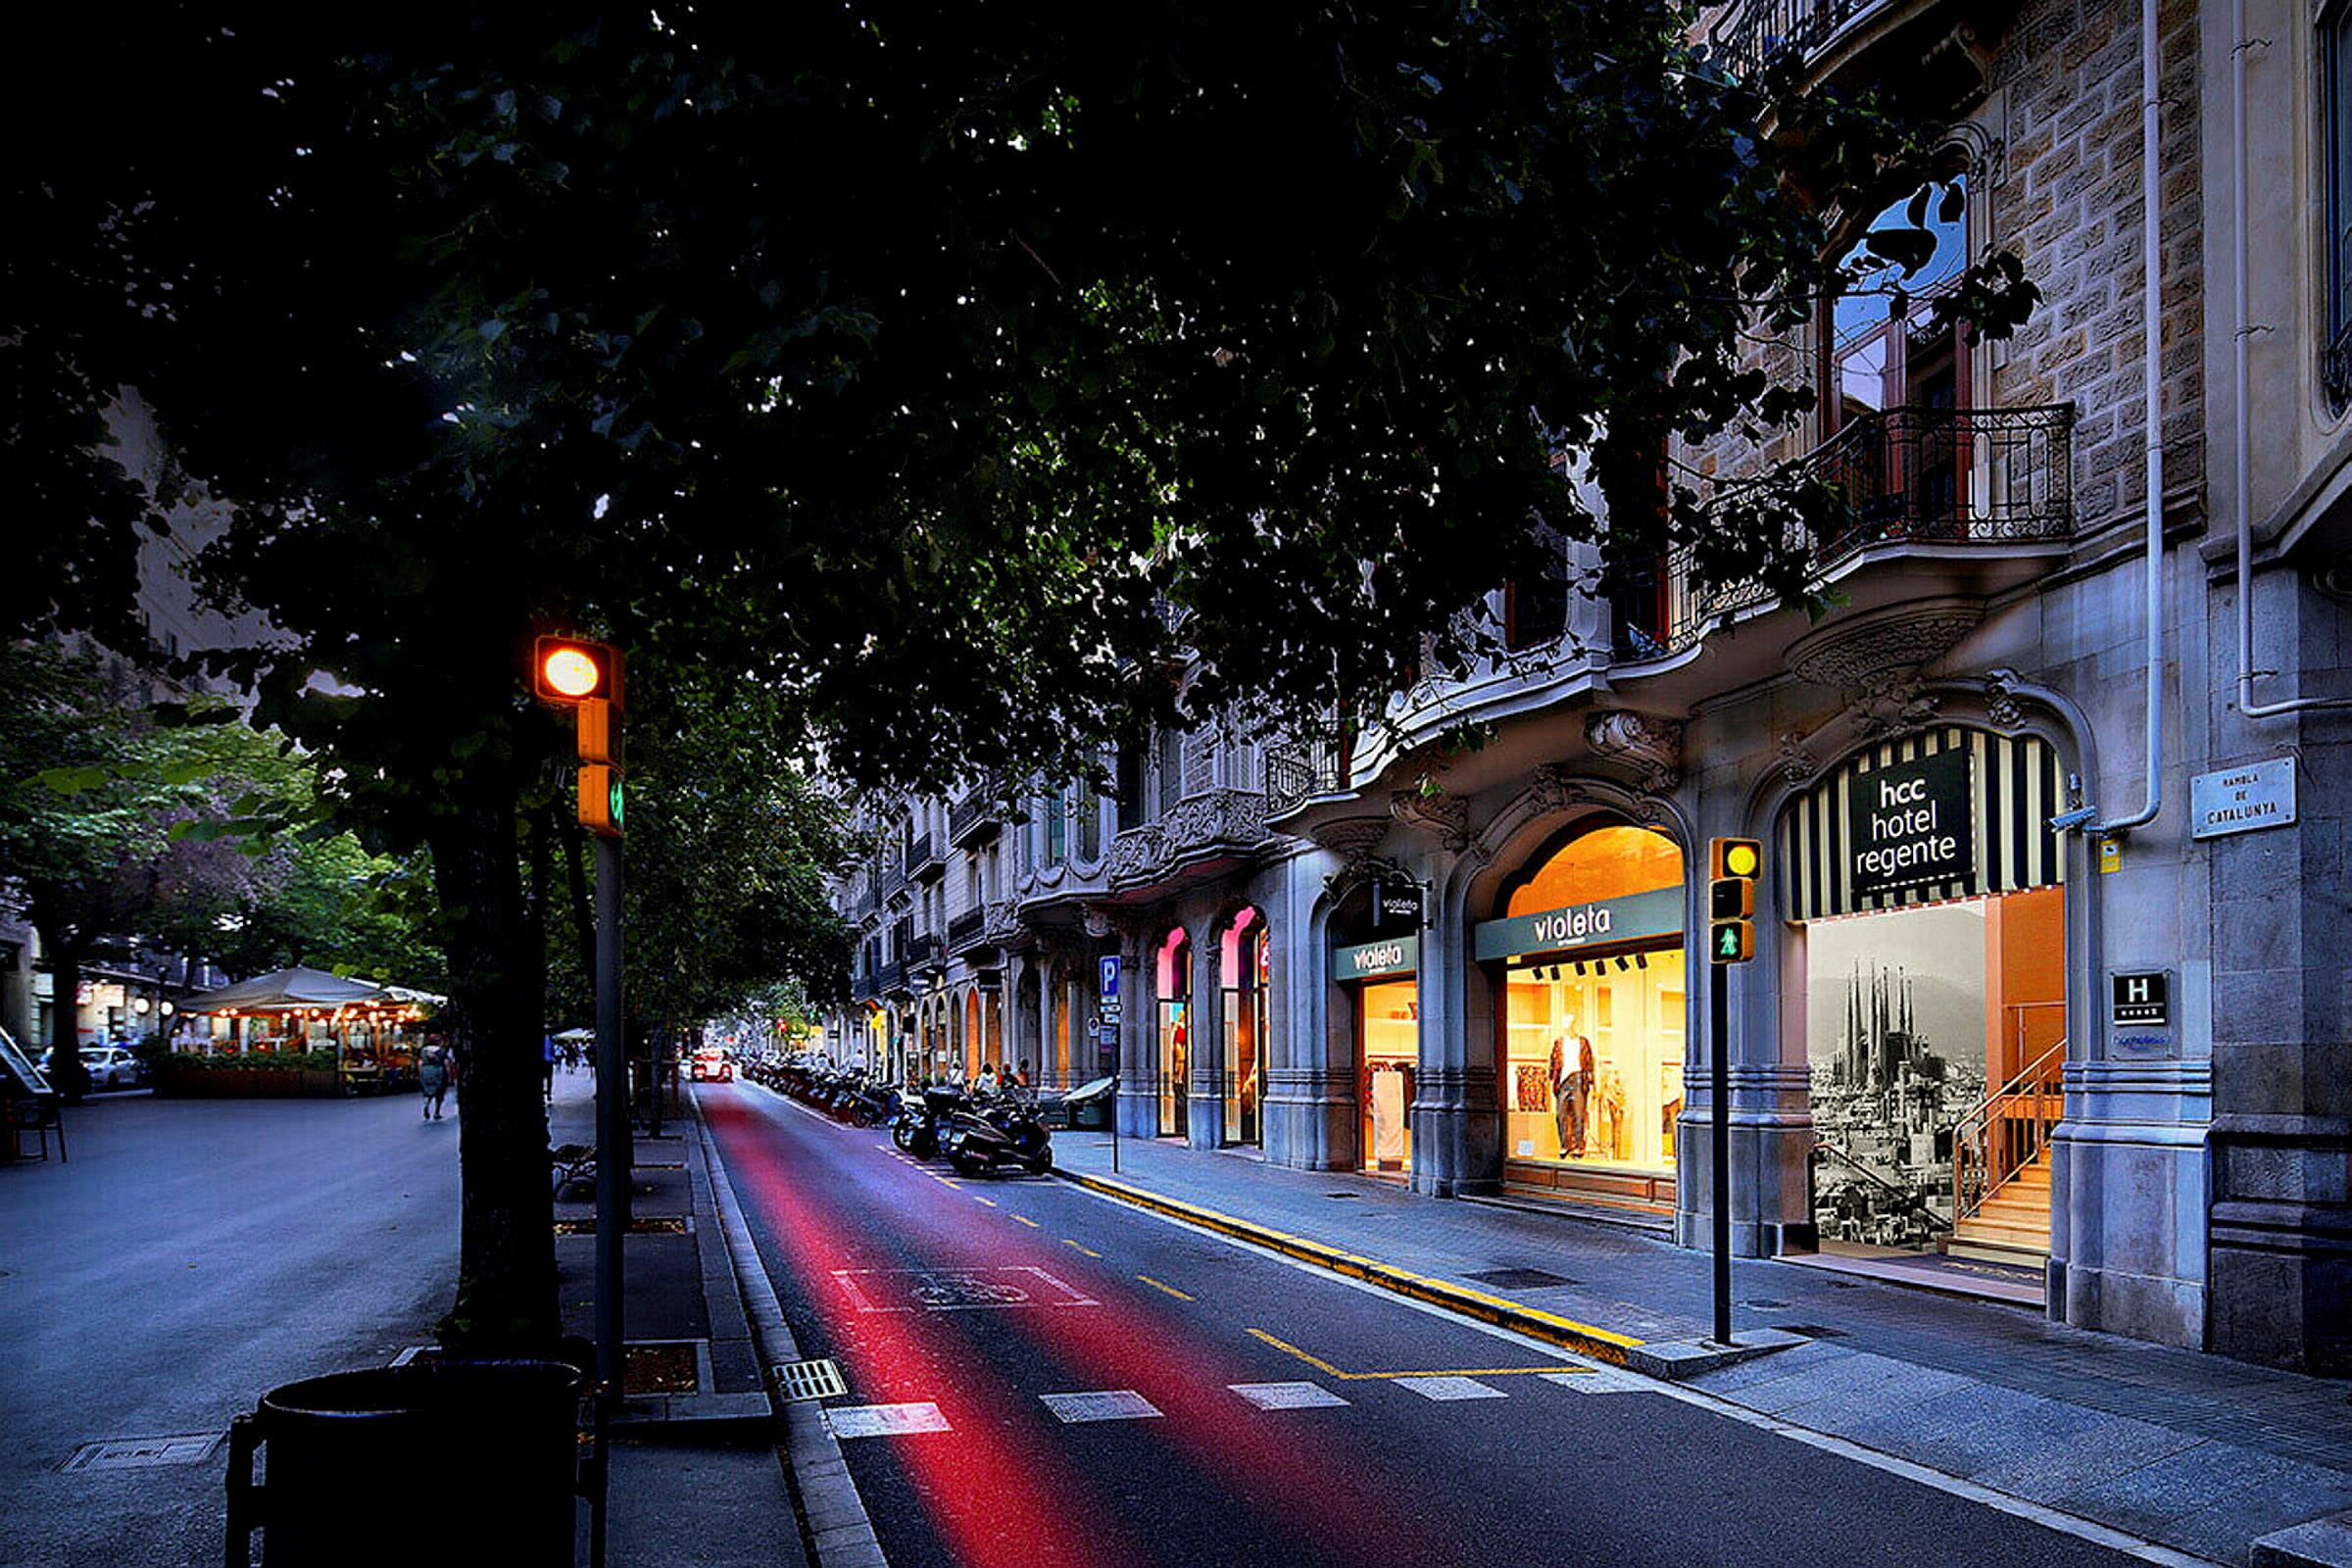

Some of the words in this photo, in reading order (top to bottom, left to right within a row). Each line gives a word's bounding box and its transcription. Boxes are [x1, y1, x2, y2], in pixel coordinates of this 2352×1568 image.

[1881, 779, 1926, 808] hcc
[1872, 800, 1936, 841] hotel
[2207, 803, 2278, 824] CATALUNYA
[1857, 835, 1956, 877] regente
[1535, 904, 1610, 942] violeta
[1353, 942, 1402, 970] violeta
[1103, 960, 1115, 993] P
[2129, 978, 2148, 1003] H
